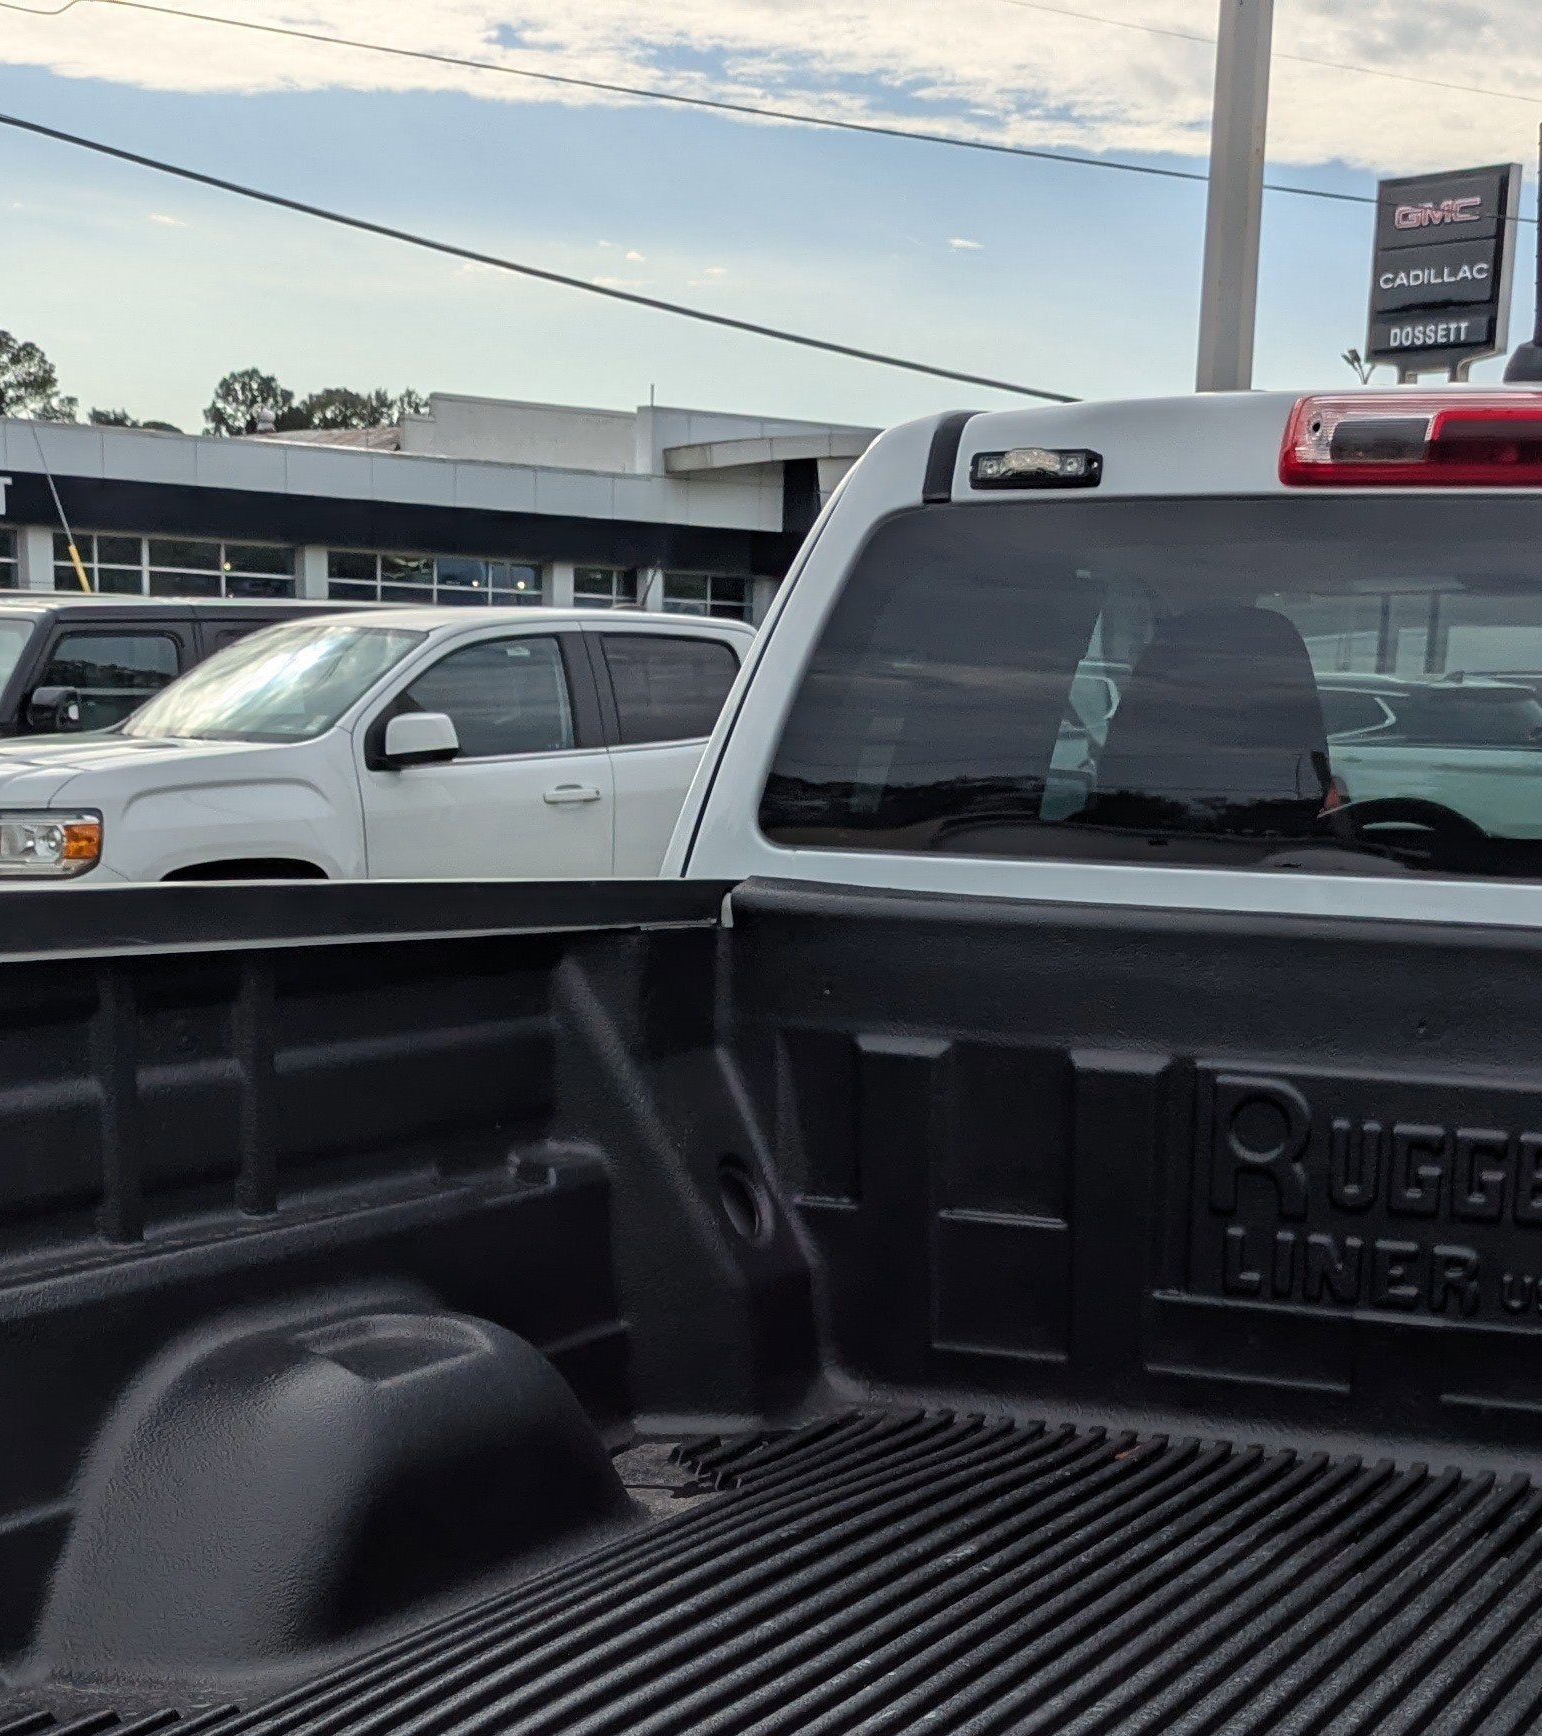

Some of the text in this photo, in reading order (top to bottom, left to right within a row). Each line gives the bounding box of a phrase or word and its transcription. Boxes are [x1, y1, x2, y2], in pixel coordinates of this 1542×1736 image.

[1394, 197, 1481, 230] GMC
[1379, 263, 1490, 289] CADILLAC
[1389, 321, 1470, 347] DOSSETT
[1222, 1226, 1479, 1317] LINER
